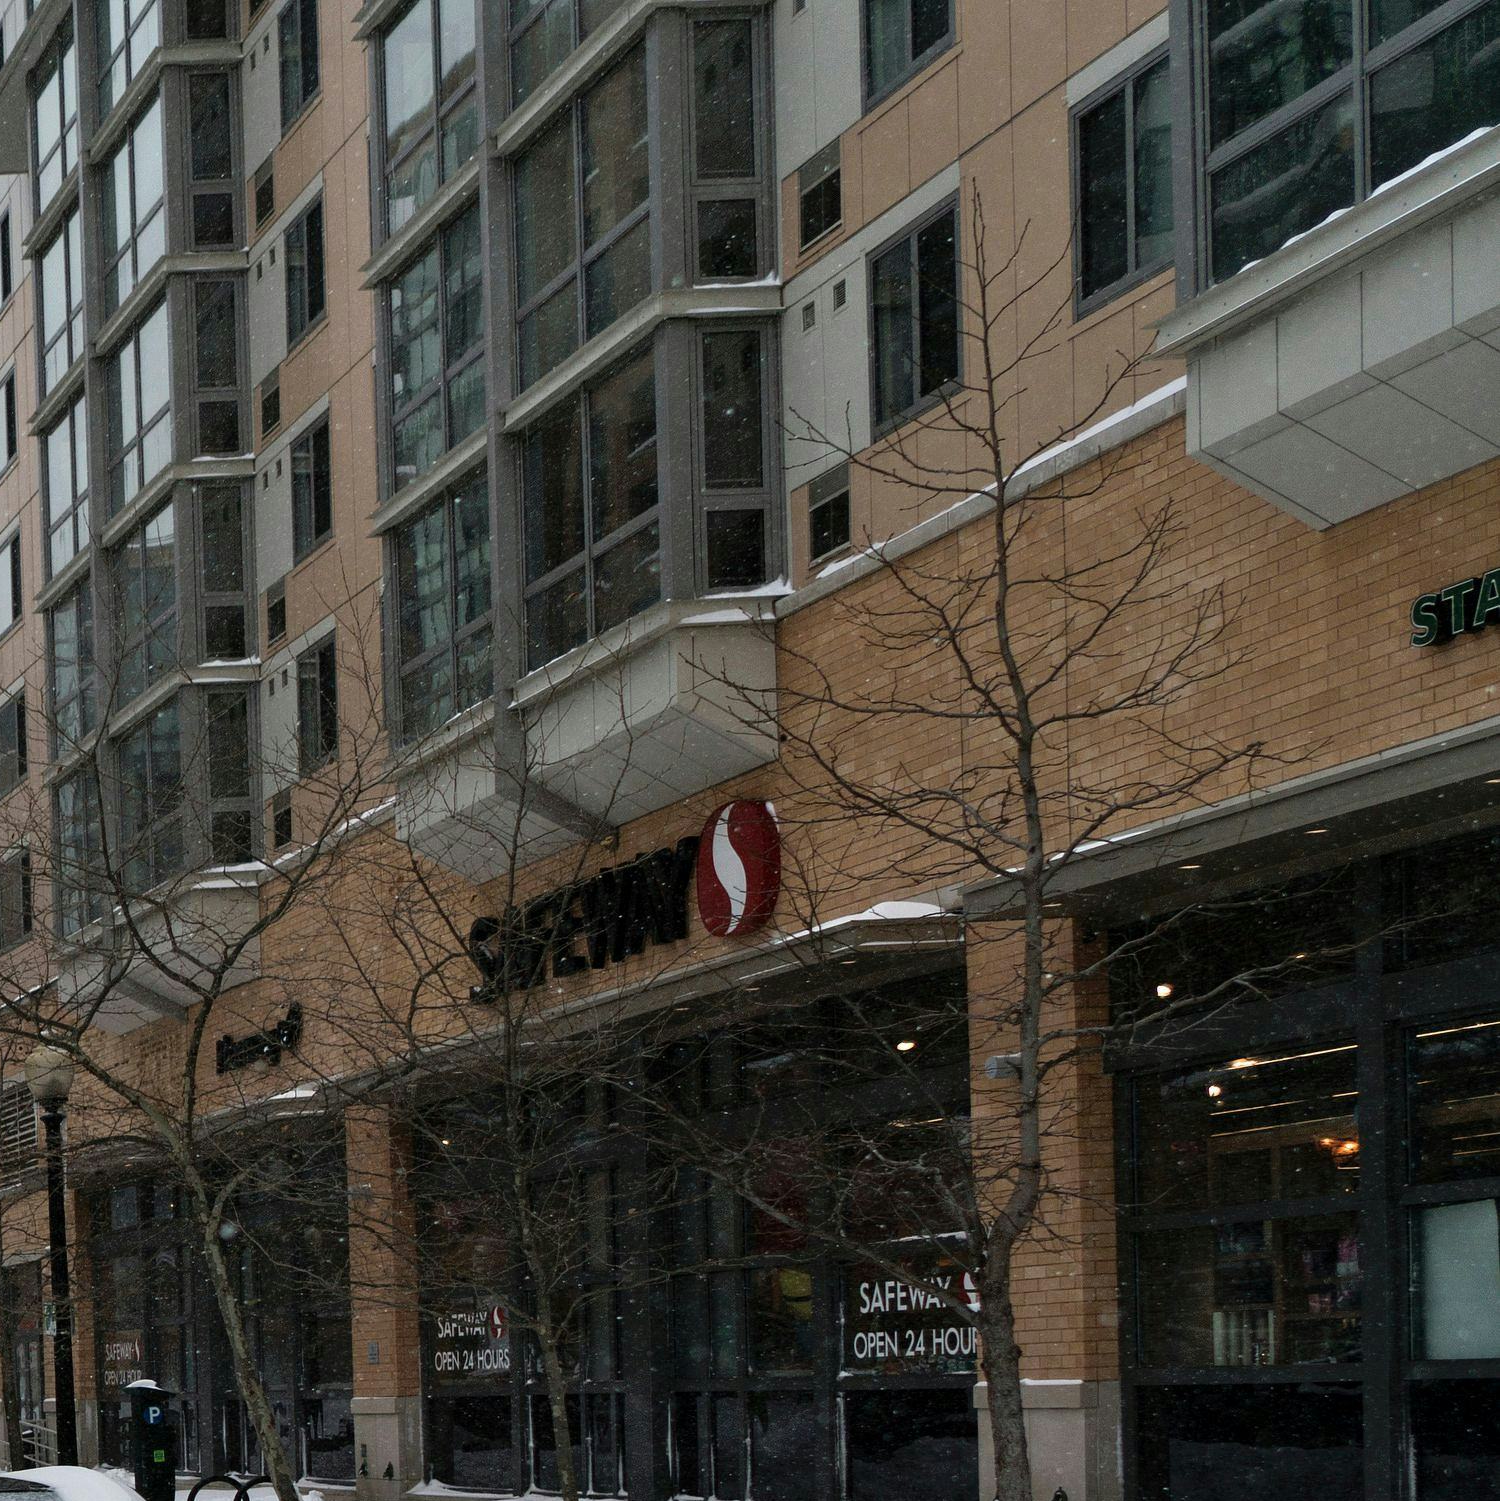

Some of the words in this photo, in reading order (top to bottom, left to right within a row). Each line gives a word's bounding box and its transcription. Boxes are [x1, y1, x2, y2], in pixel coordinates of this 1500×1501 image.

[853, 1330, 898, 1359] OPEN
[905, 1329, 925, 1357] 24
[434, 1351, 460, 1371] OPEN
[463, 1350, 474, 1370] 24
[477, 1348, 510, 1370] HOURS
[148, 1406, 161, 1424] P
